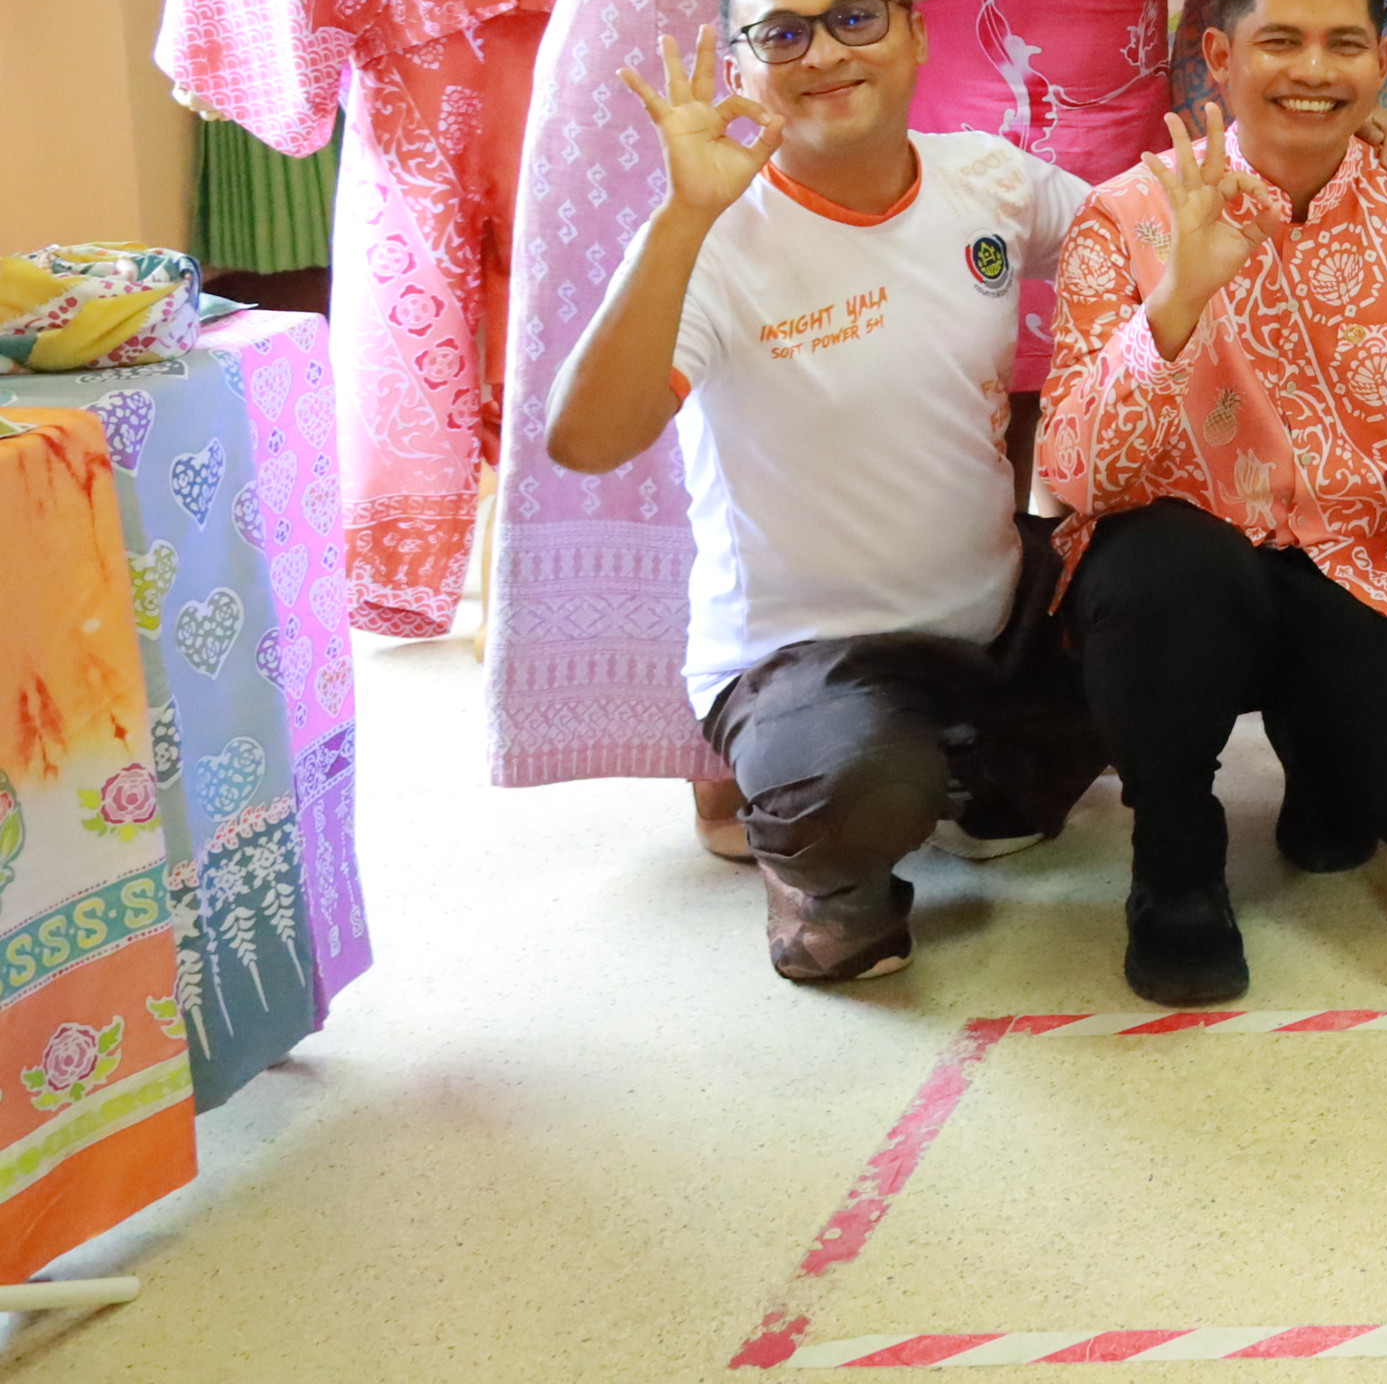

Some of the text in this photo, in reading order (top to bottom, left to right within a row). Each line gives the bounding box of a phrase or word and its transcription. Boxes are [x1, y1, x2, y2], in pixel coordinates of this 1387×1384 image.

[759, 286, 888, 343] INSIGHT YALA
[770, 342, 805, 360] SOFT
[811, 324, 861, 354] POWER
